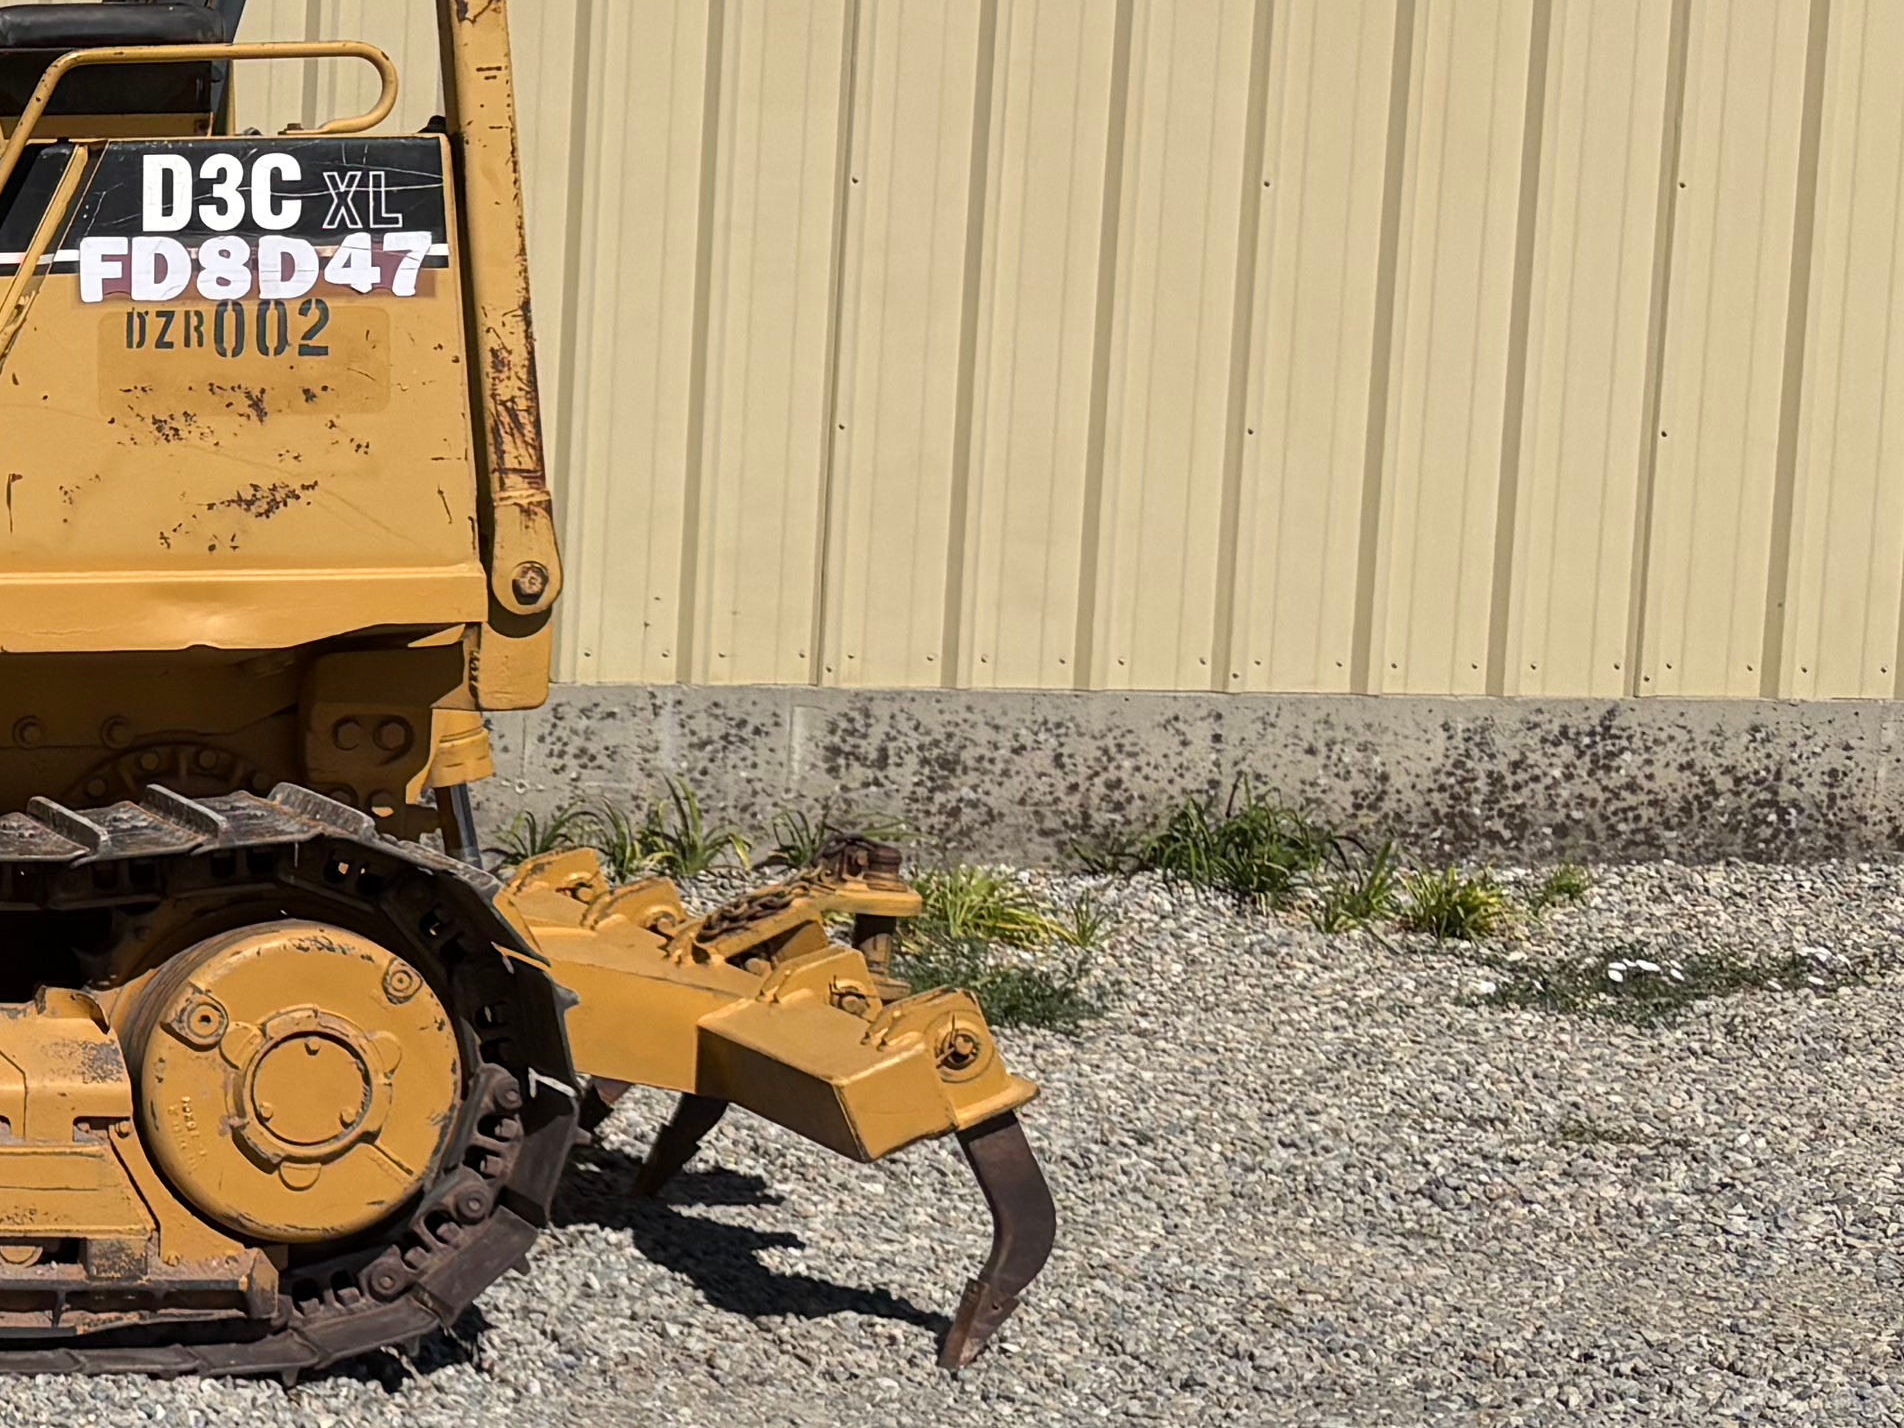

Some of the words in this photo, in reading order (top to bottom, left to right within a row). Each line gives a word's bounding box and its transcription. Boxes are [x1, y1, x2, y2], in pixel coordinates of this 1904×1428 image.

[142, 152, 302, 232] D3C
[322, 170, 403, 229] XL
[79, 231, 433, 303] FD8D47
